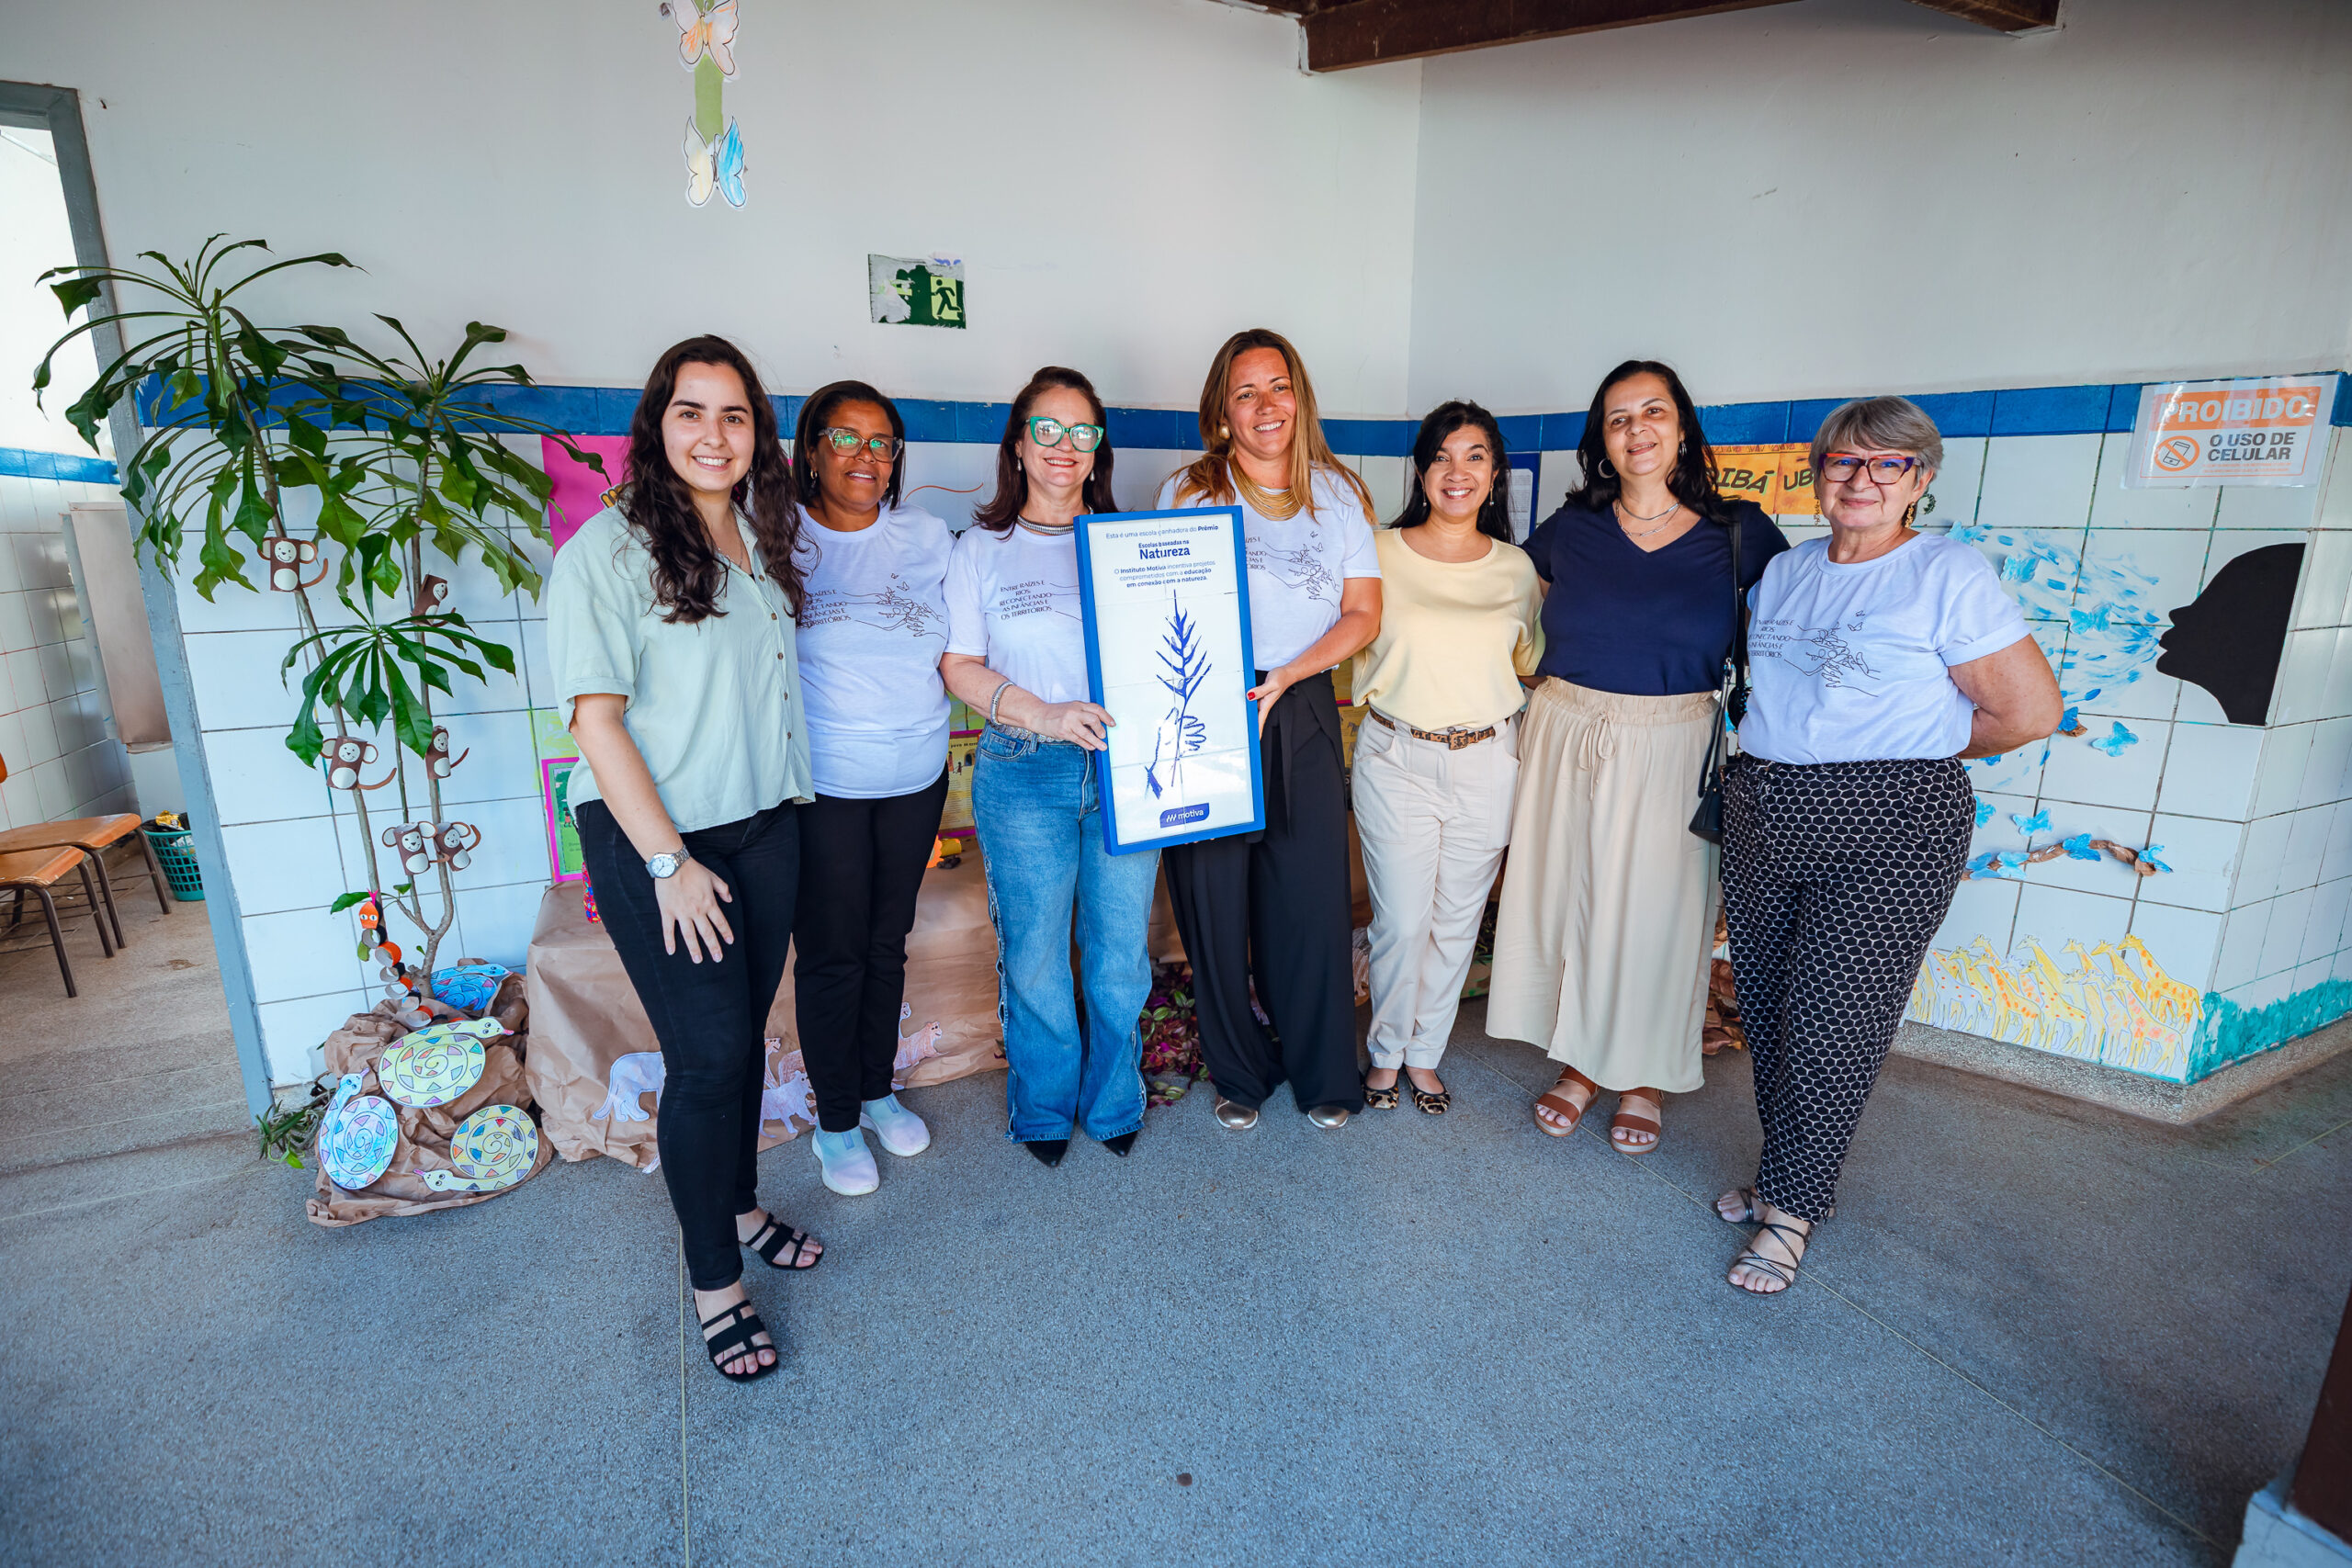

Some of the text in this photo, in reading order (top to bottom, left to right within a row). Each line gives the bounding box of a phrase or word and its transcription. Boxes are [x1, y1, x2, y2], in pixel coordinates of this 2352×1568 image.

[2159, 395, 2309, 424] PROIBIDO
[2209, 432, 2296, 447] O USO DE
[2207, 446, 2291, 462] CELULAR
[1783, 468, 1815, 491] UB
[1158, 527, 1189, 536] ganhadora
[1139, 547, 1191, 559] Natureza
[1119, 572, 1165, 581] comprometidos
[1000, 592, 1053, 606] RECONECTANDO
[1178, 809, 1204, 819] motiva
